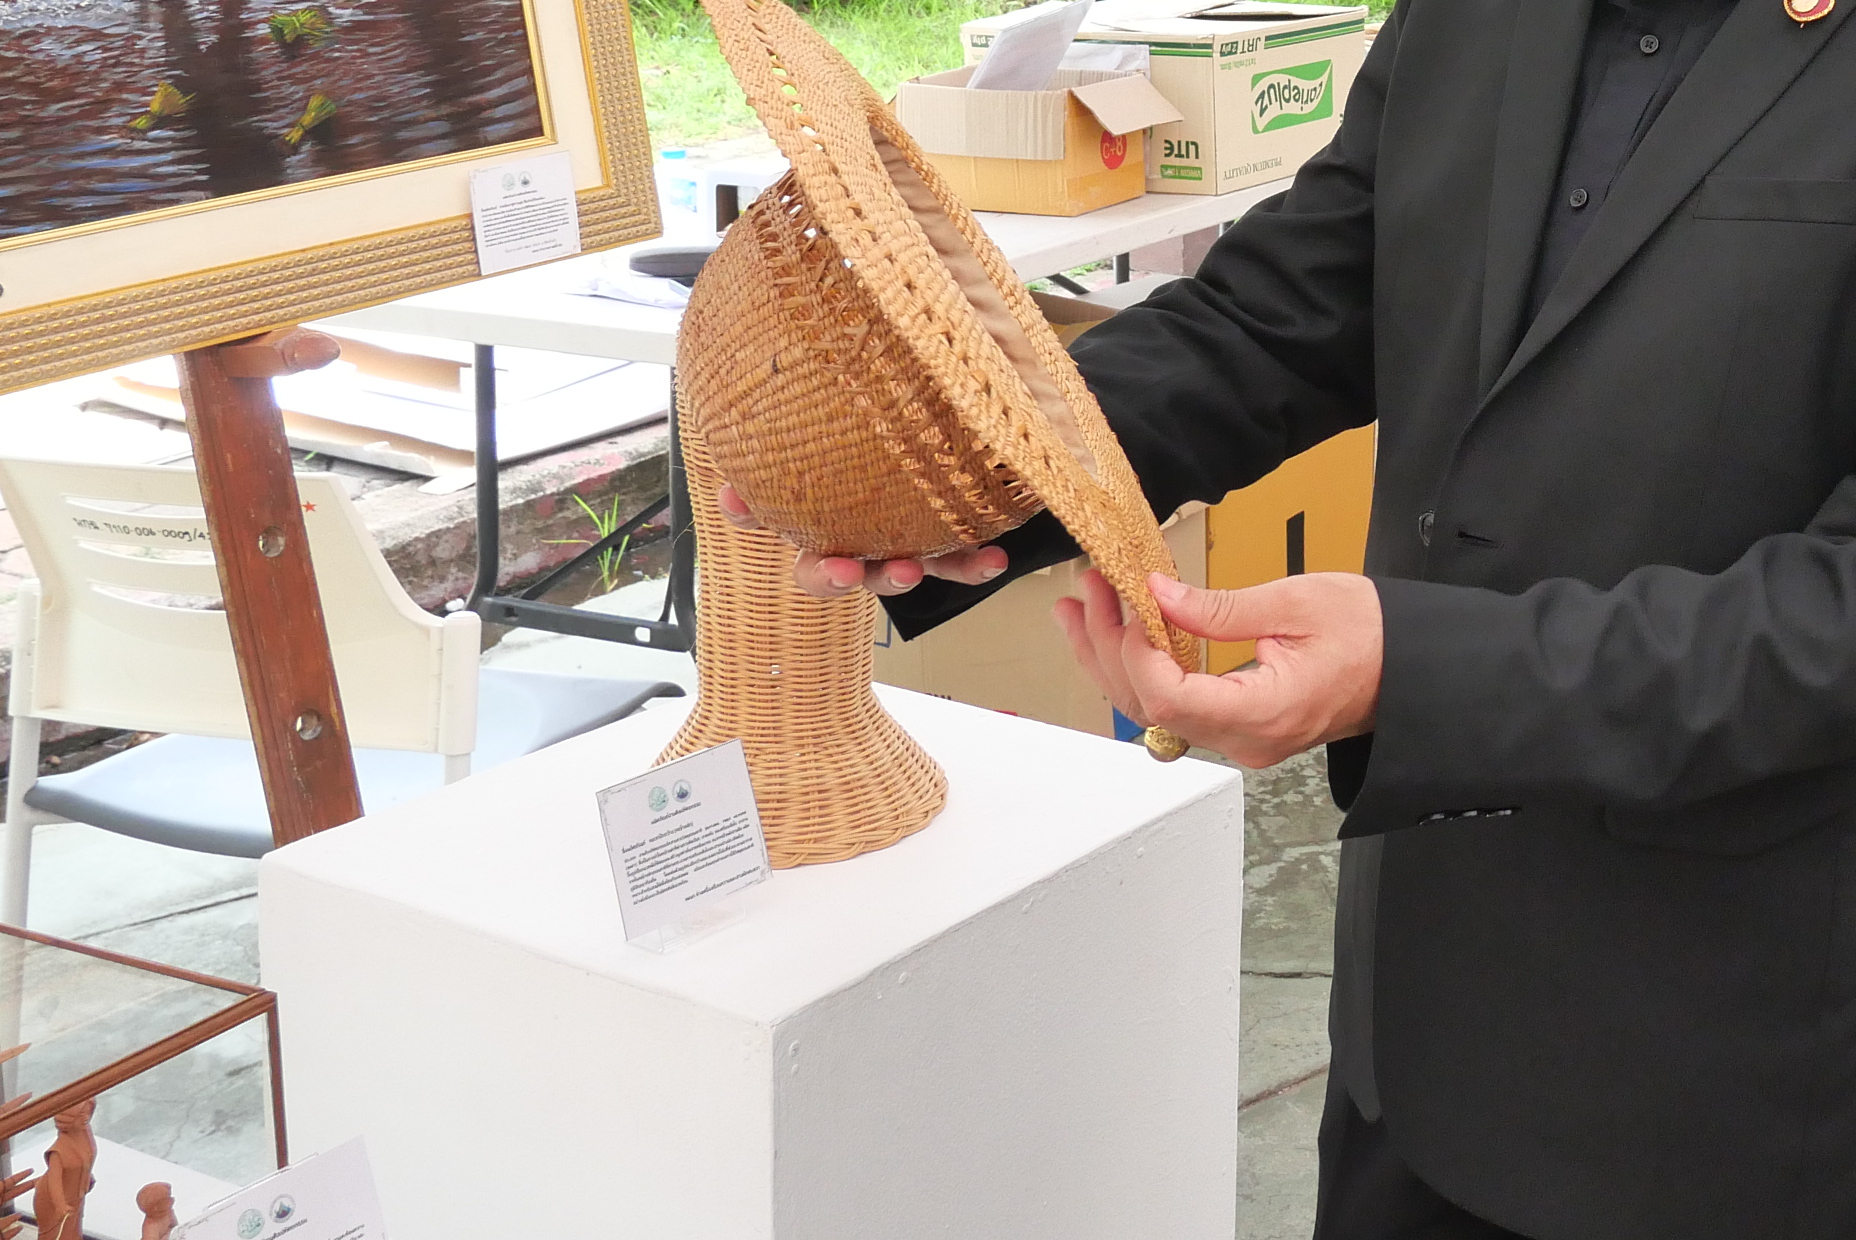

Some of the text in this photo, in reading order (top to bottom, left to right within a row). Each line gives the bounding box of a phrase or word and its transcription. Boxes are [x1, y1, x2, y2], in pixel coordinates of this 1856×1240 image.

[1239, 36, 1261, 54] JRT
[1163, 139, 1199, 159] LITE
[1223, 157, 1283, 181] PREMIUM QUALITY
